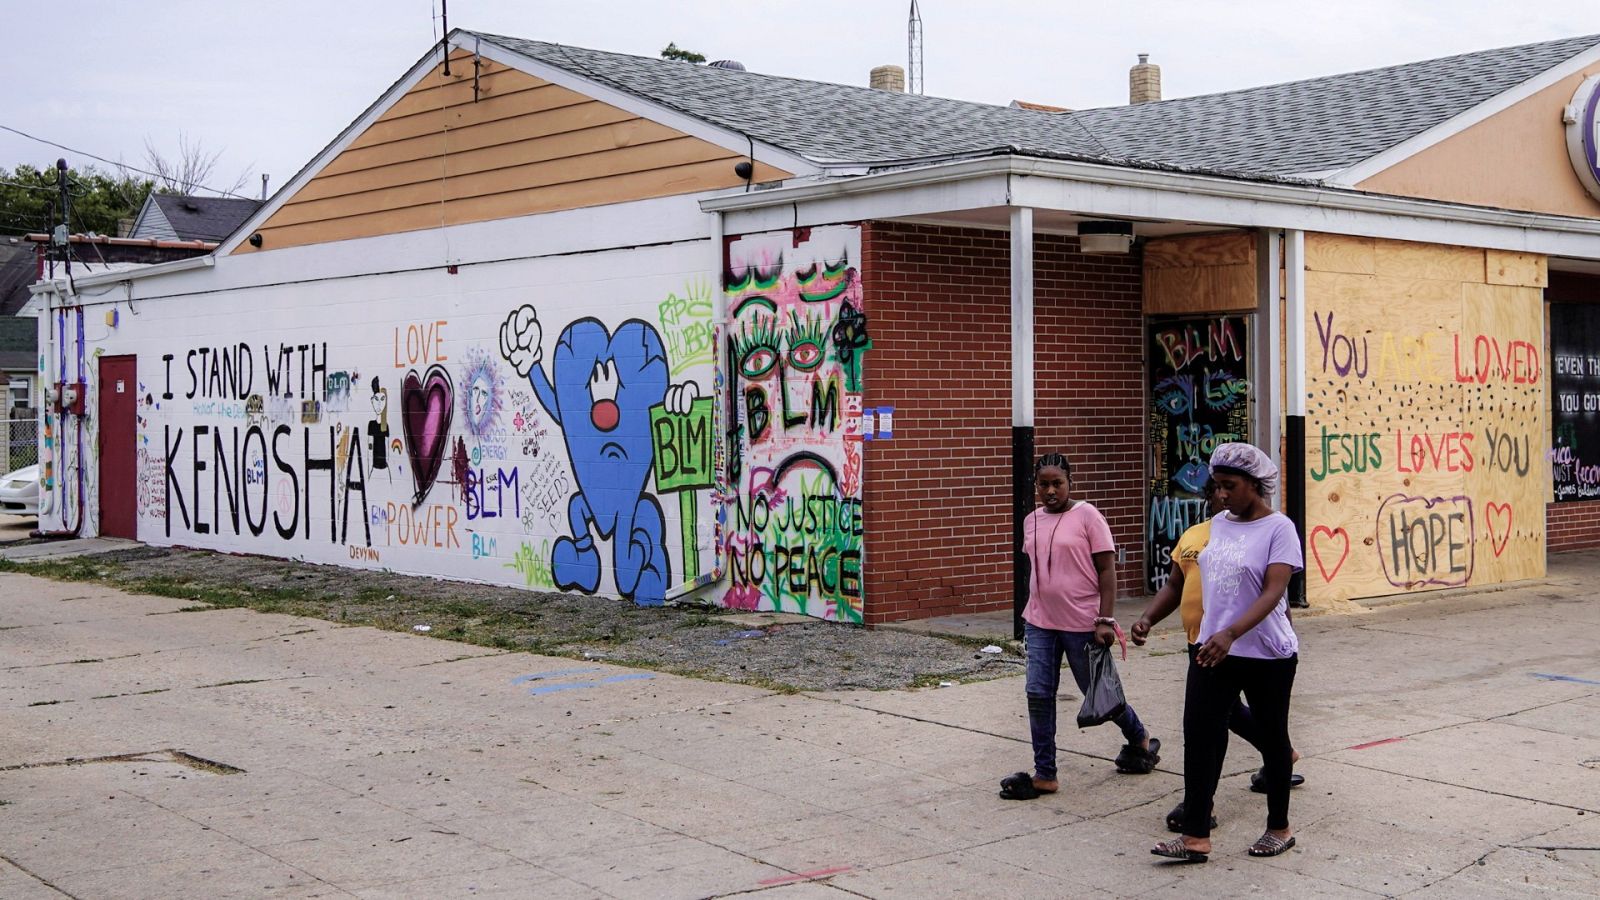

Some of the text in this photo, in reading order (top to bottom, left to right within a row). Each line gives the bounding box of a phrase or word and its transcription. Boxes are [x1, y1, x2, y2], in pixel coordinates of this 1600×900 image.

[394, 321, 448, 368] LOVE
[1155, 318, 1243, 370] BLM
[1379, 331, 1444, 382] ARE
[1454, 334, 1540, 385] LOVED
[162, 342, 327, 402] I STAND WITH
[745, 353, 841, 438] BLM
[1559, 394, 1580, 412] YOU
[481, 445, 507, 461] ENERGY
[654, 415, 706, 481] BLM
[1310, 425, 1382, 481] JESUS
[1396, 428, 1475, 473] LOVES
[1485, 427, 1530, 477] YOU
[165, 424, 371, 547] KENOSHA
[247, 468, 264, 485] BLM
[466, 466, 519, 520] BLM
[537, 470, 569, 519] SEEDS
[387, 502, 460, 549] POWER
[737, 493, 863, 536] NO JUSTICE
[472, 534, 497, 559] BLM
[1156, 544, 1171, 565] is
[1390, 508, 1466, 577] HOPE
[730, 543, 861, 598] NO PEACE
